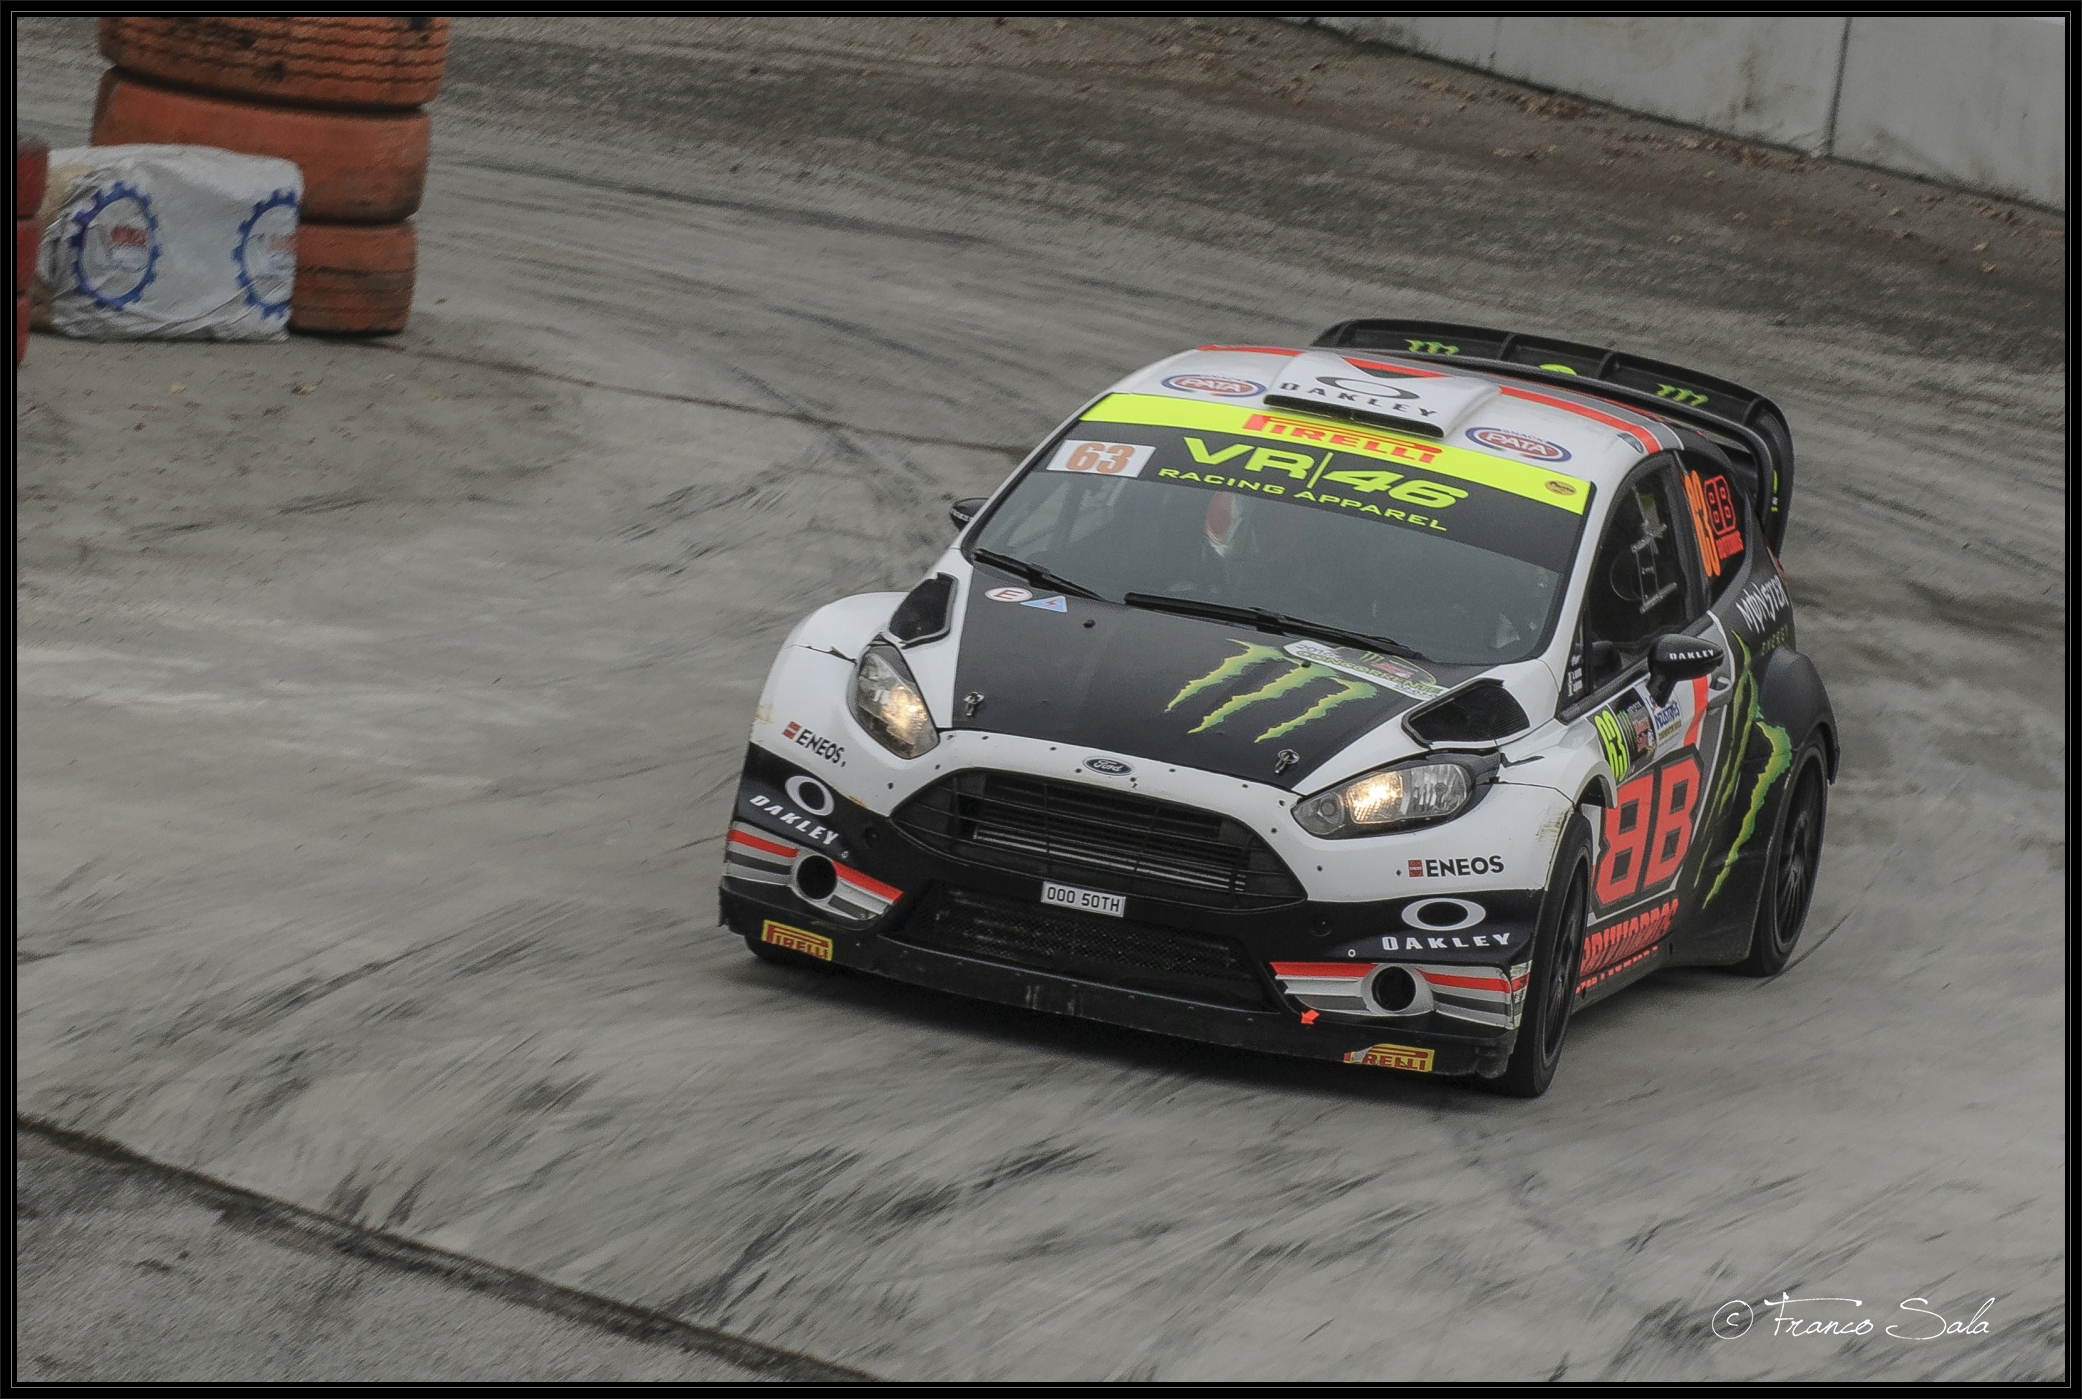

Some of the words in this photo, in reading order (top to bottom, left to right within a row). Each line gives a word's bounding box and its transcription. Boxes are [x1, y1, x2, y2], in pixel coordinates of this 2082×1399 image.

[1280, 382, 1437, 417] OAKLEY
[1243, 413, 1443, 464] PIRELLI
[1485, 432, 1548, 456] PATA
[1066, 442, 1135, 474] 63
[1158, 467, 1286, 495] RACING
[1294, 490, 1447, 531] APPAREL
[1668, 649, 1715, 661] OAKLEY
[795, 728, 845, 764] ENEOS
[1594, 710, 1628, 782] 63
[749, 794, 839, 845] OAKLEY
[1425, 855, 1504, 877] ENEOS
[766, 923, 829, 960] PIRELLI
[1382, 932, 1510, 952] OAKLEY
